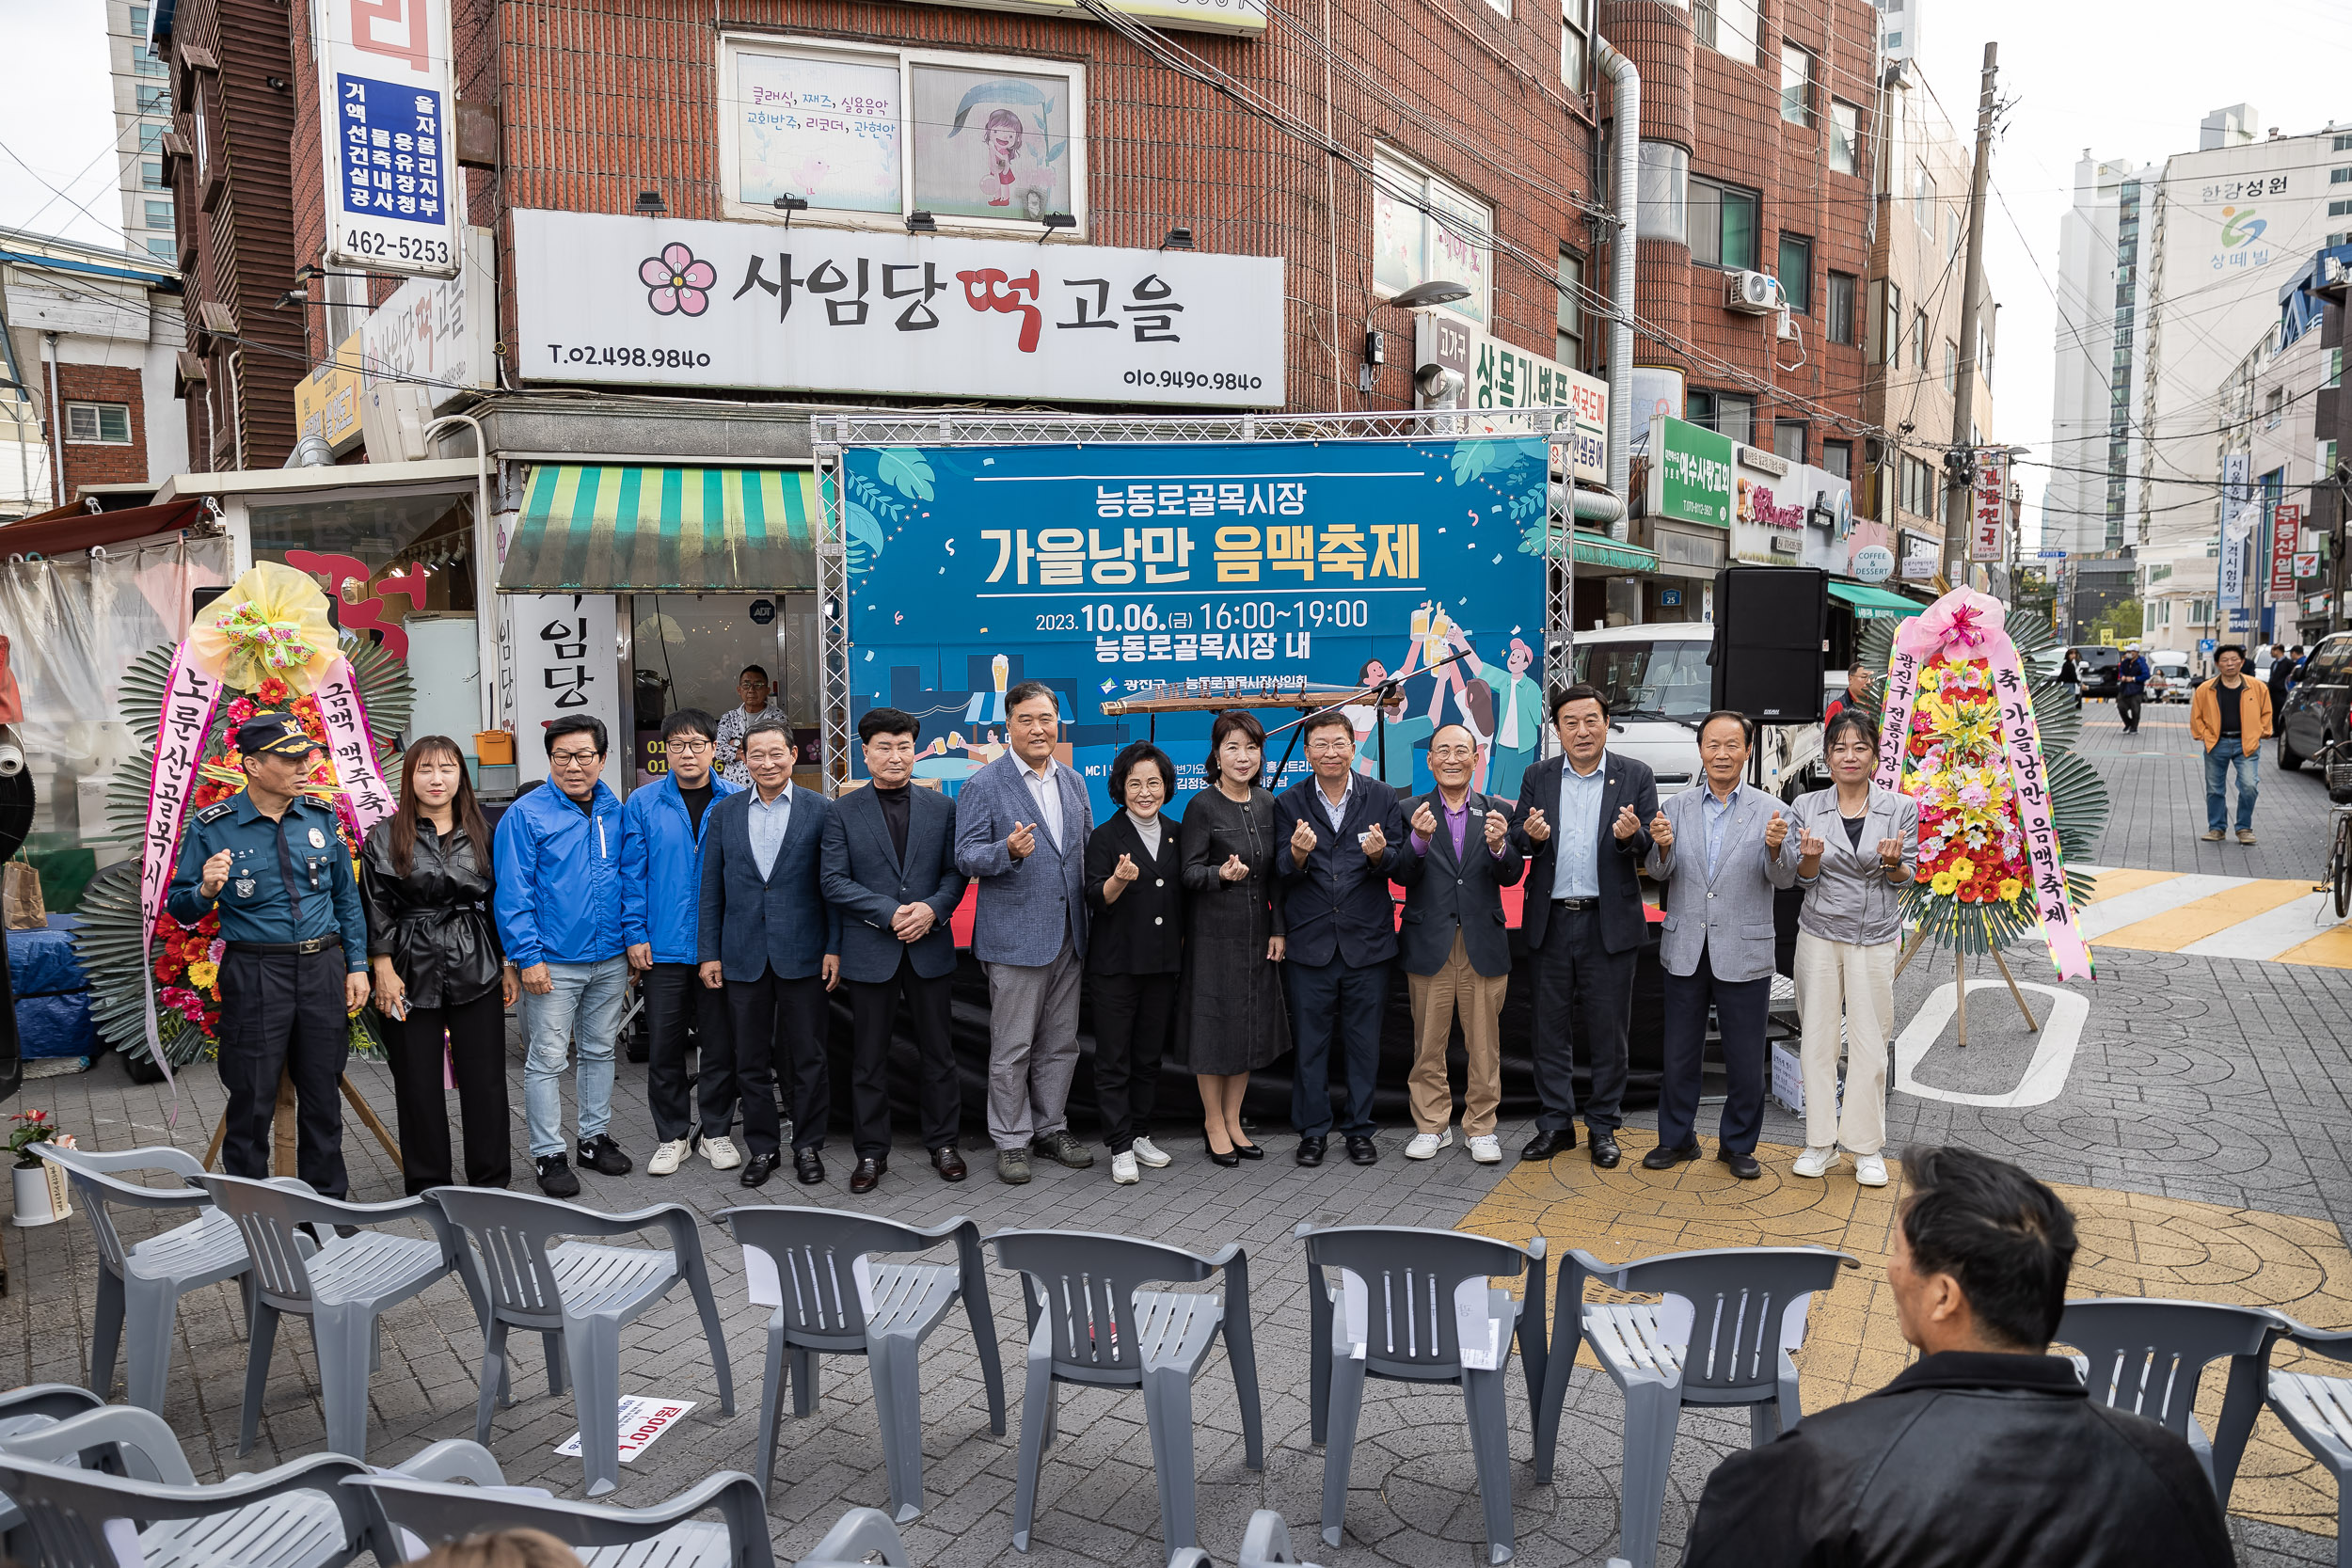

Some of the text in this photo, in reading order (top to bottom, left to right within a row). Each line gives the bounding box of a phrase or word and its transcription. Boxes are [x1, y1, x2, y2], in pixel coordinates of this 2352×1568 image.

[344, 81, 436, 115] 거울
[753, 86, 798, 108] 클래식,
[841, 96, 889, 117] 실용음악
[344, 102, 437, 135] 액자
[747, 110, 897, 140] 교회반주, 리코더, 관현악
[347, 145, 438, 178] 건축유리
[348, 166, 439, 198] 실내장치
[349, 187, 439, 218] 공사청부
[346, 229, 450, 264] 462-5253
[2210, 248, 2269, 271] 상떼빌
[548, 344, 711, 369] T.02.498.9840
[1439, 325, 1466, 363] 고가구
[1124, 369, 1263, 391] 010.9490.9840
[1095, 482, 1308, 518] 능동로골목시장
[1978, 468, 2000, 546] 김밥천국
[980, 523, 1421, 585] 가을낭만 음맥축제
[1855, 567, 1889, 576] DESSERT
[754, 607, 771, 617] ADT
[1036, 613, 1079, 631] 2023.
[1200, 599, 1369, 631] 16:00~19:00
[538, 594, 596, 708] 임당
[1095, 631, 1311, 663] 능동로골목시장 내
[335, 741, 389, 832] 맥주축
[1085, 765, 1101, 777] MC
[1995, 668, 2070, 927] 축 가을낭만 음맥축제
